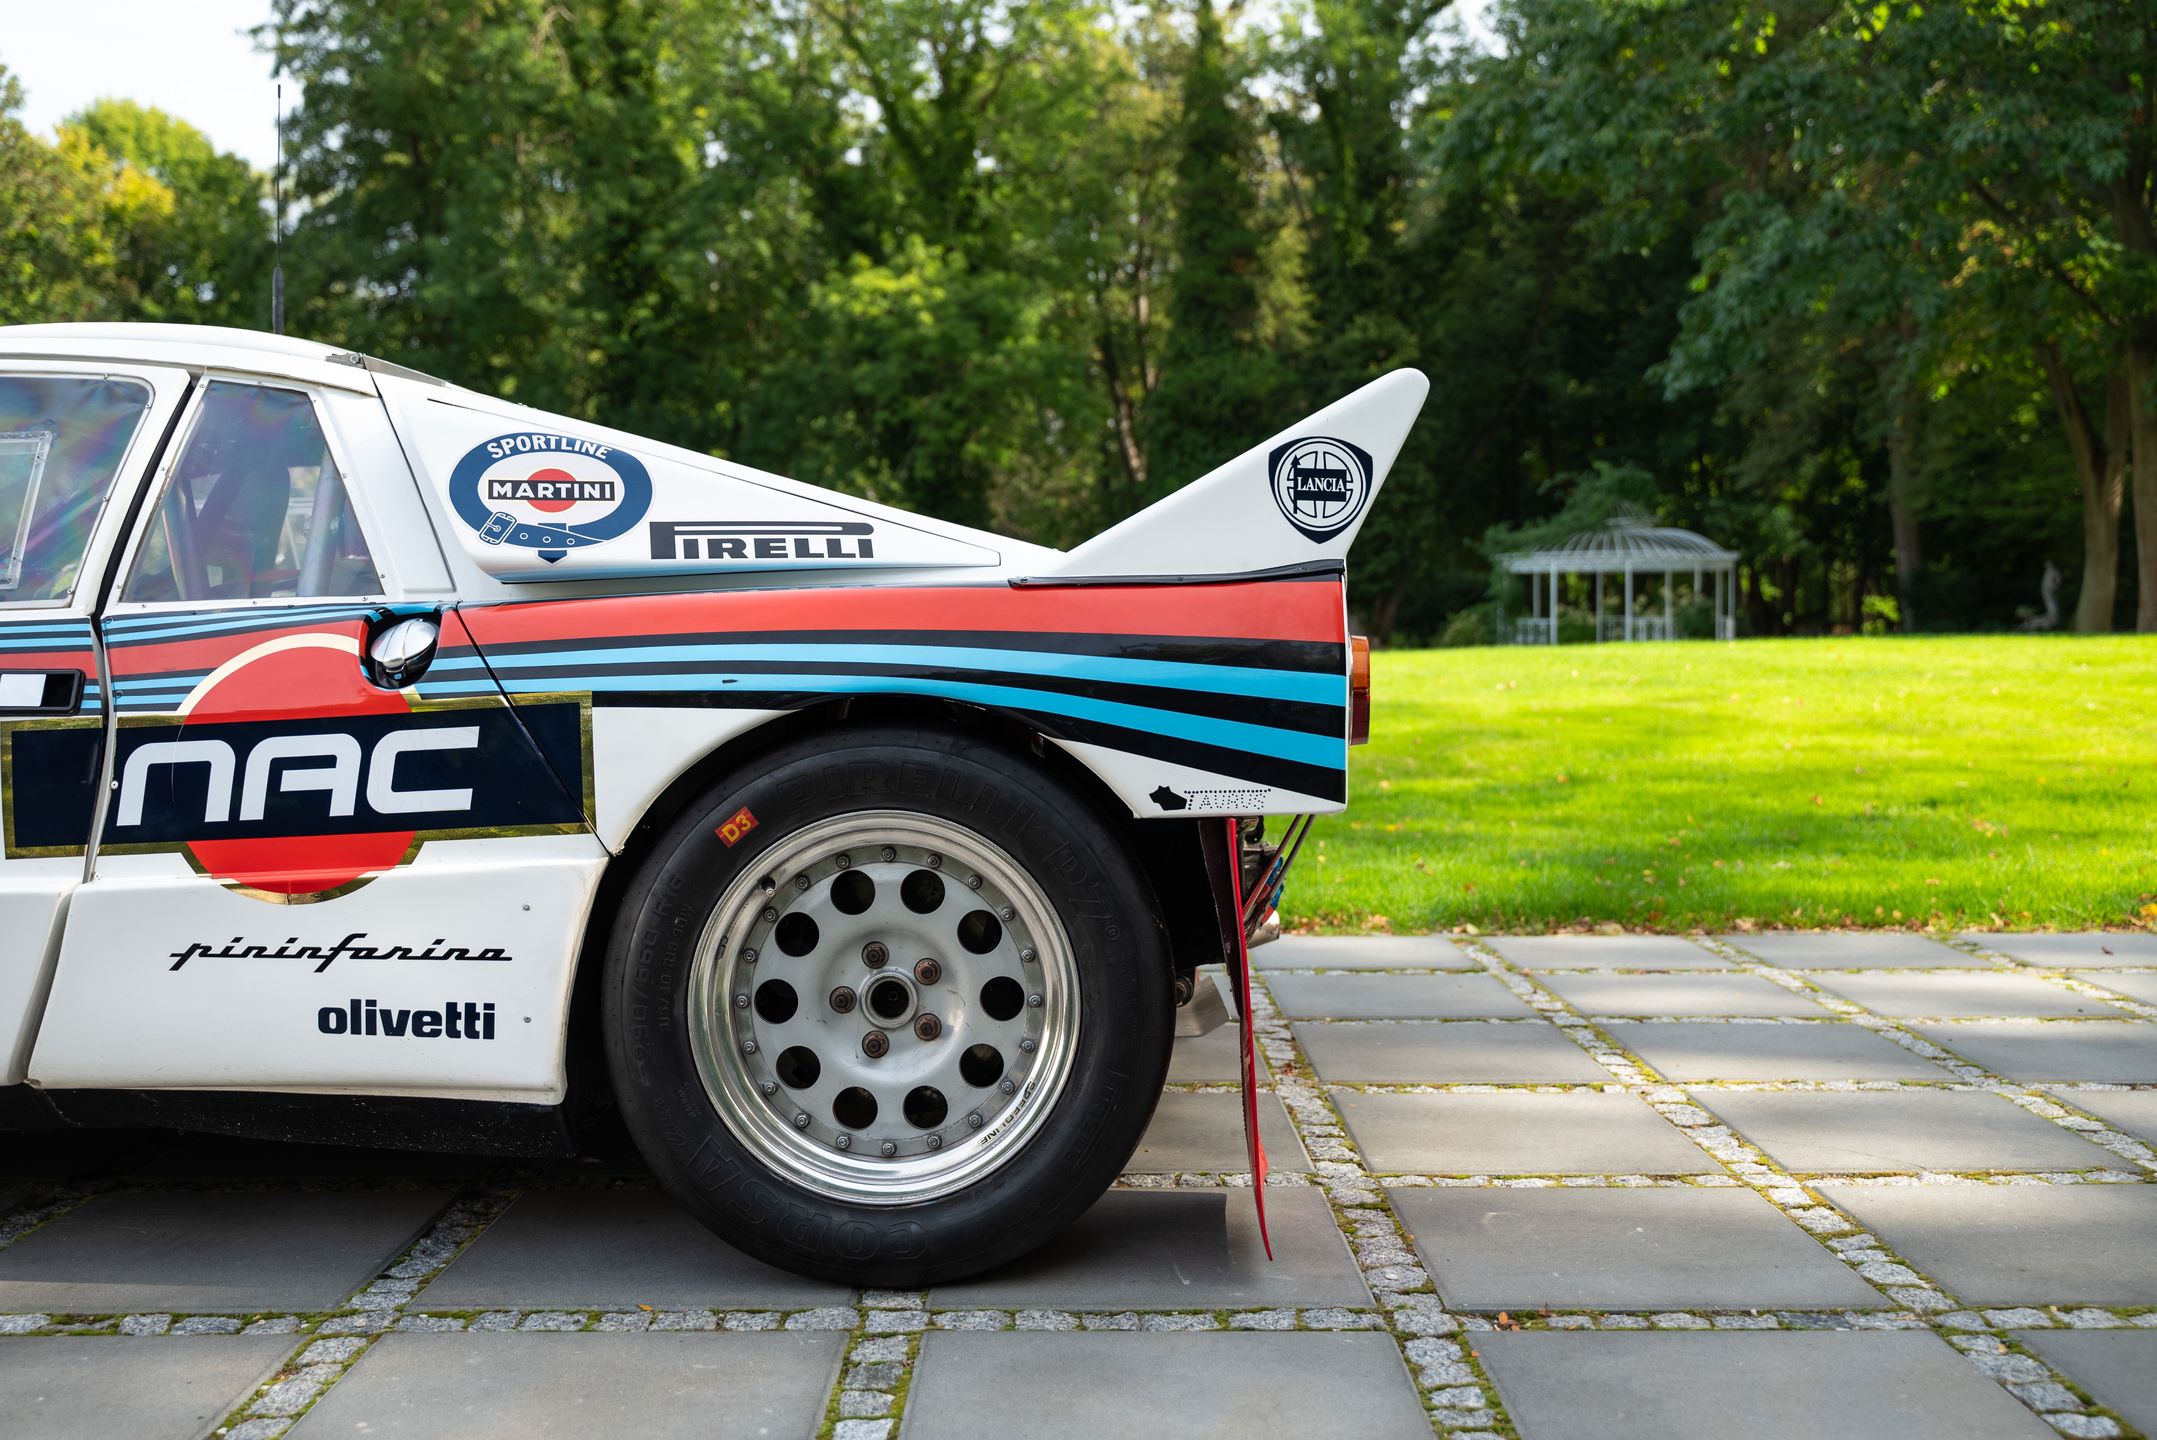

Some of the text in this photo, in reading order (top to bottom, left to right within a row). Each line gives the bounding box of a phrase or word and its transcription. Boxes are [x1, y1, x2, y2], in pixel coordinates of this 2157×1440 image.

[486, 434, 612, 459] SPORTLINE
[492, 481, 613, 499] MARTINI
[1297, 476, 1346, 492] LANCIA
[649, 521, 874, 559] PIRELLI
[1184, 789, 1271, 810] TAURUS
[721, 814, 752, 842] D3
[169, 933, 512, 972] pininfarina
[318, 999, 495, 1040] olivetti
